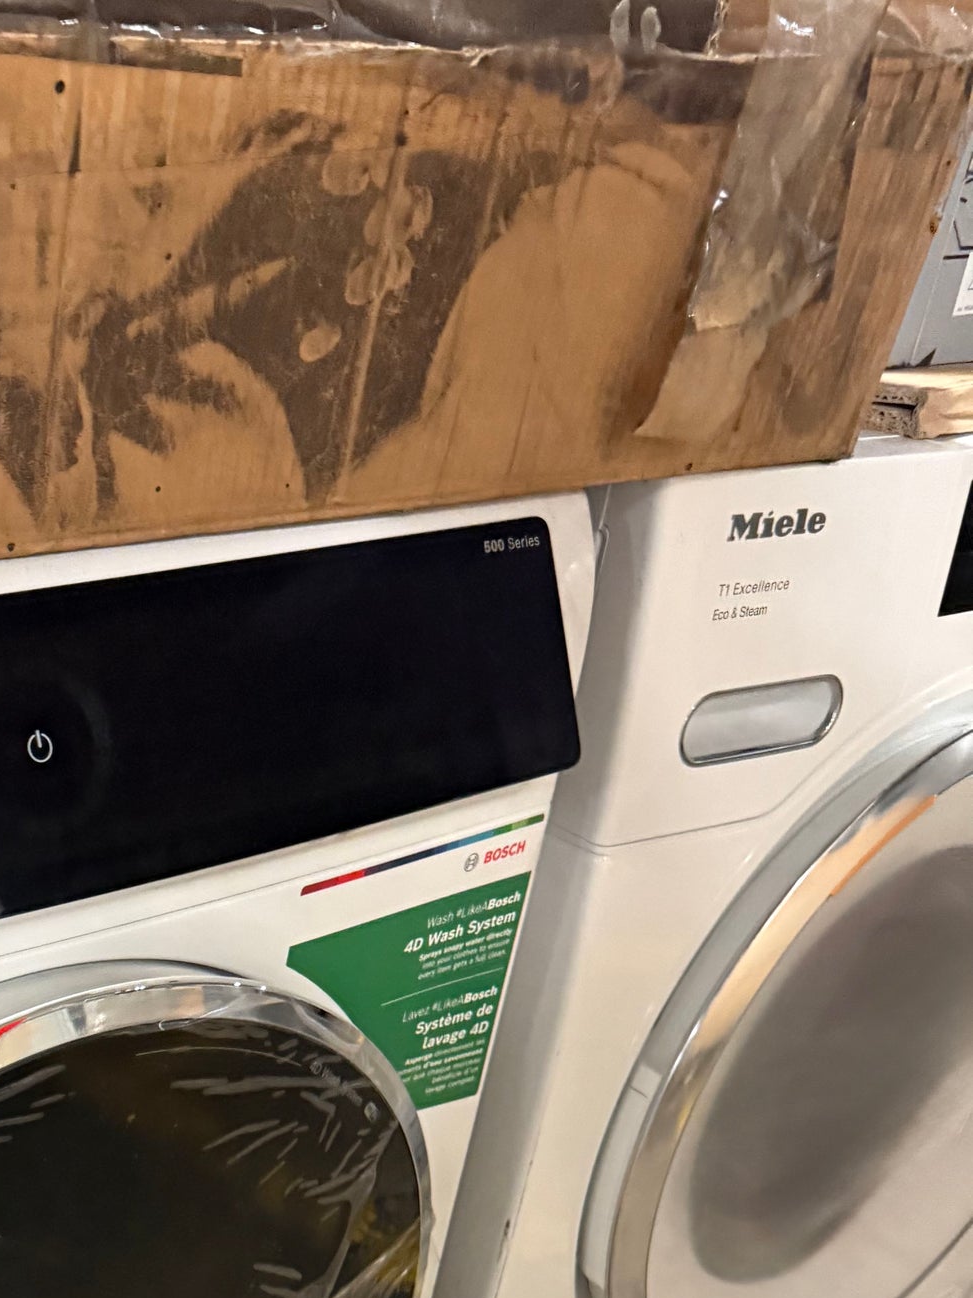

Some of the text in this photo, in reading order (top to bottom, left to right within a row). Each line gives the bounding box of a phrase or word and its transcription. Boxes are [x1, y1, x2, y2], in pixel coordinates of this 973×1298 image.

[727, 508, 826, 542] Miele
[483, 535, 540, 553] 500 Series
[718, 579, 790, 597] T1 Excellence
[712, 604, 768, 621] Eco & Steam
[483, 840, 526, 864] BOSCH
[403, 911, 516, 953] 4D Wash System
[427, 911, 454, 929] Wash
[415, 1003, 494, 1035] Système de
[422, 1021, 489, 1049] lavage 4D
